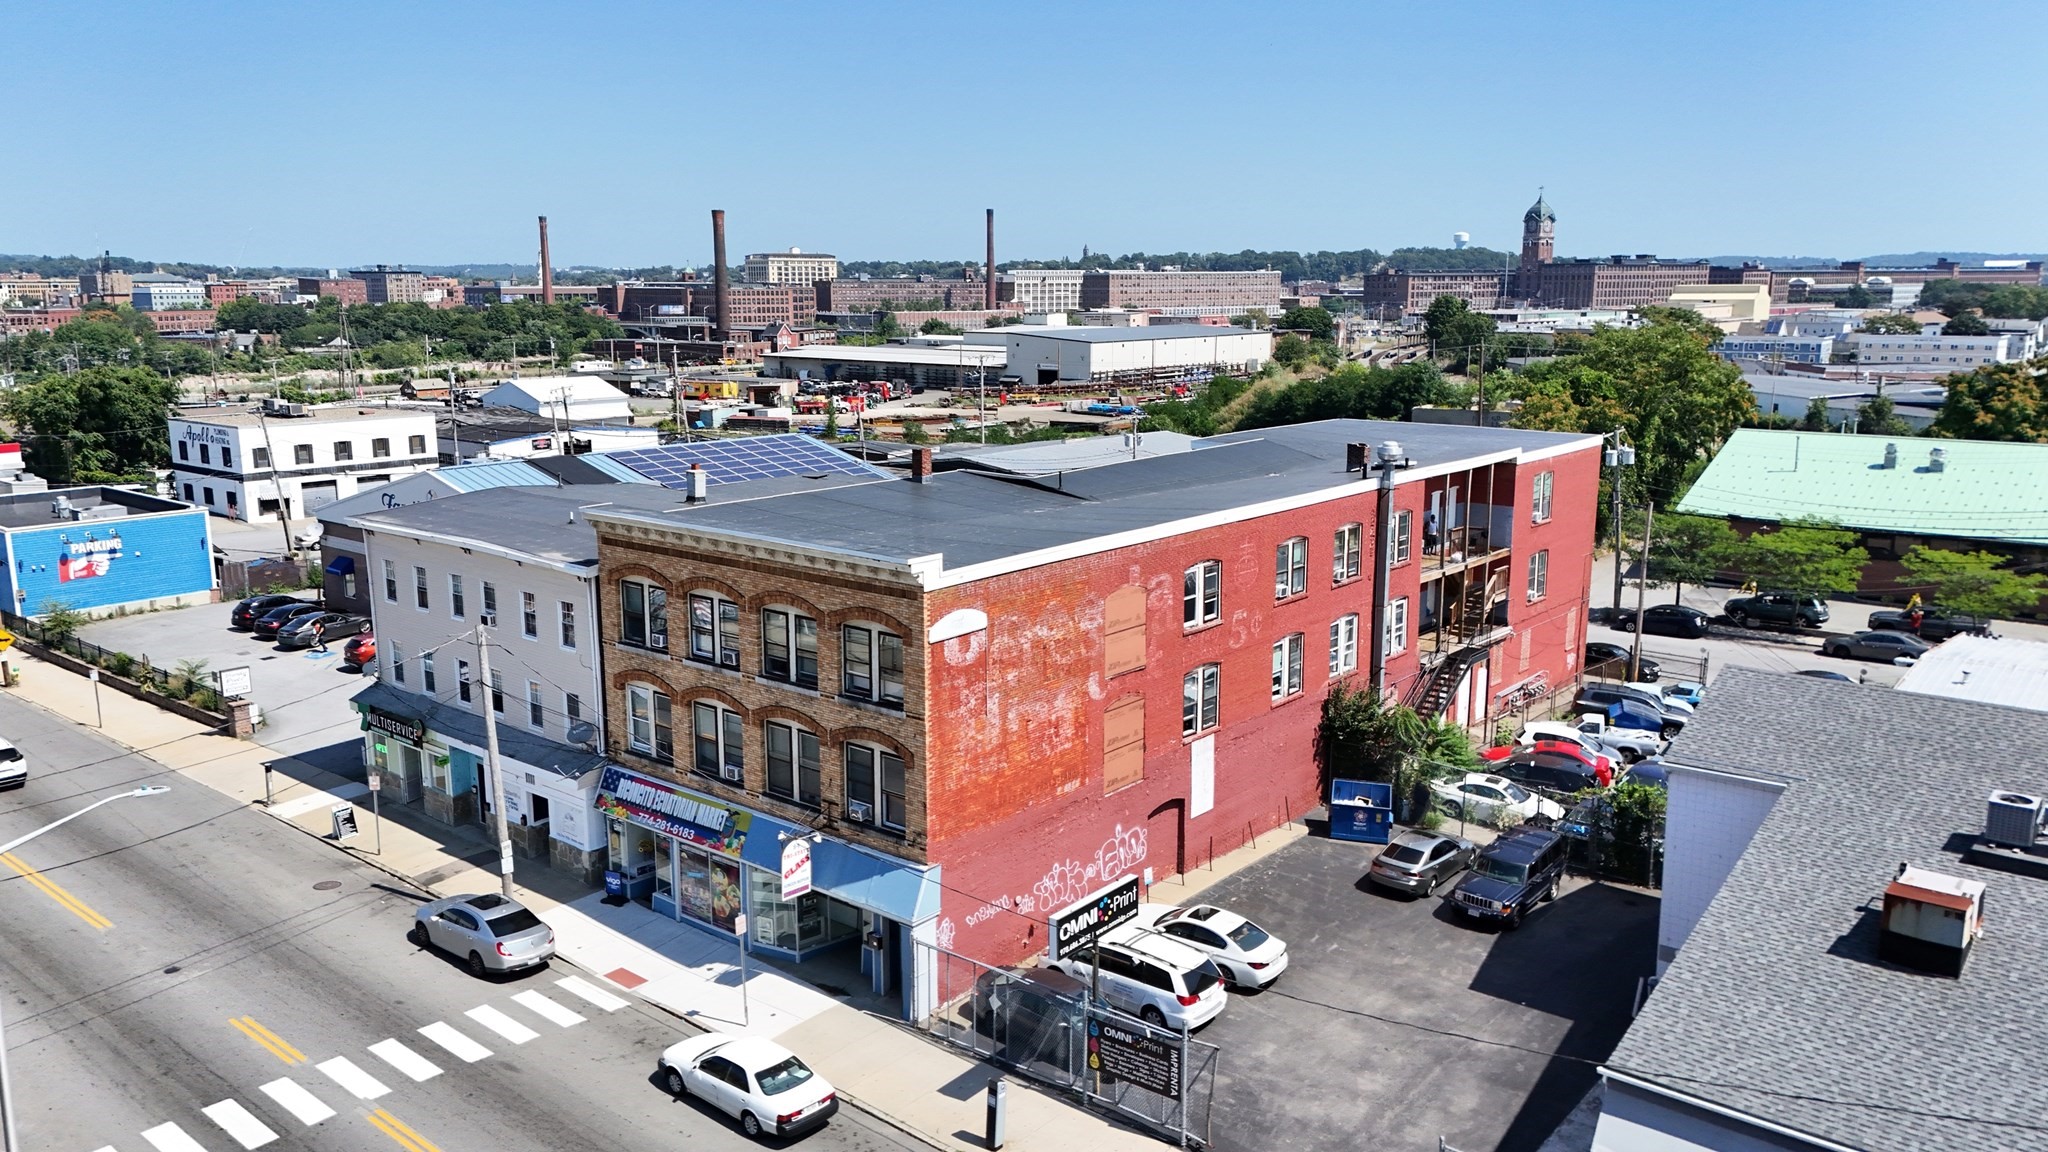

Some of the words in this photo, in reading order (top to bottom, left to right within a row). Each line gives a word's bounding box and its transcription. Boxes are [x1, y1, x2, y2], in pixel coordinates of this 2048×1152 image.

[183, 425, 215, 448] Apollo
[70, 538, 123, 555] PARKING
[366, 711, 419, 742] MULTISERVICE
[638, 812, 695, 840] 774-281-6183
[653, 790, 699, 823] ECUATORIAN
[694, 803, 729, 833] MARKET
[784, 853, 810, 879] GLASS
[1059, 906, 1098, 941] OMNI
[1113, 885, 1138, 913] Print
[1103, 1026, 1132, 1044] OMNI
[1143, 1040, 1164, 1055] Print
[1170, 1049, 1179, 1096] IMPRENTA
